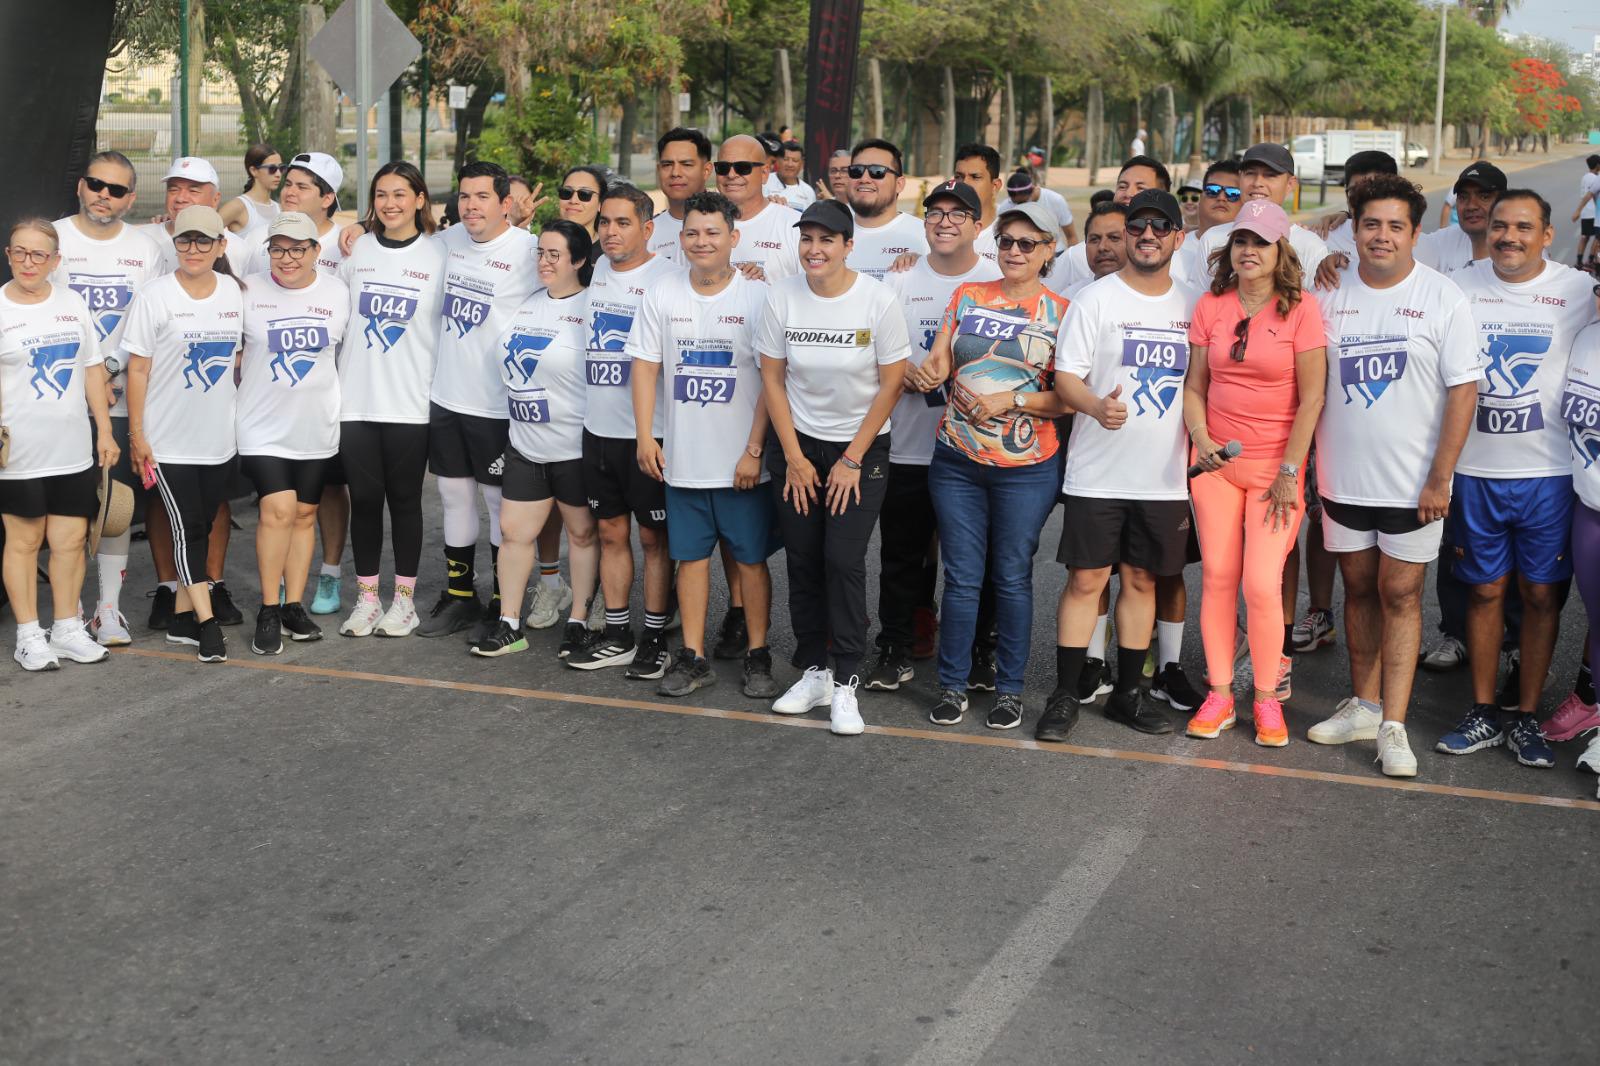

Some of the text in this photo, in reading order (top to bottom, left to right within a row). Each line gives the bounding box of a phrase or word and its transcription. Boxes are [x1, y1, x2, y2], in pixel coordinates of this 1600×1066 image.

[760, 240, 782, 250] ISDE
[123, 259, 144, 268] ISDE
[318, 258, 338, 269] ISDE
[490, 260, 512, 272] ISDE
[409, 270, 431, 281] ISDE
[81, 286, 119, 308] 133
[634, 287, 645, 296] IS
[370, 295, 408, 318] 044
[1541, 296, 1567, 308] ISDE
[314, 307, 333, 317] ISDE
[451, 298, 483, 324] 046
[1402, 308, 1425, 319] ISDE
[61, 315, 80, 323] ISDE
[724, 315, 745, 325] ISDE
[974, 317, 1016, 339] 134
[20, 336, 41, 347] XXIX
[280, 328, 320, 350] 050
[677, 339, 695, 347] XXIX
[785, 330, 855, 344] PRODEMAZ
[1135, 343, 1176, 368] 049
[590, 362, 622, 385] 028
[1354, 354, 1398, 381] 104
[686, 377, 727, 401] 052
[512, 401, 541, 422] 103
[1563, 395, 1600, 427] 136
[1488, 407, 1531, 433] 027
